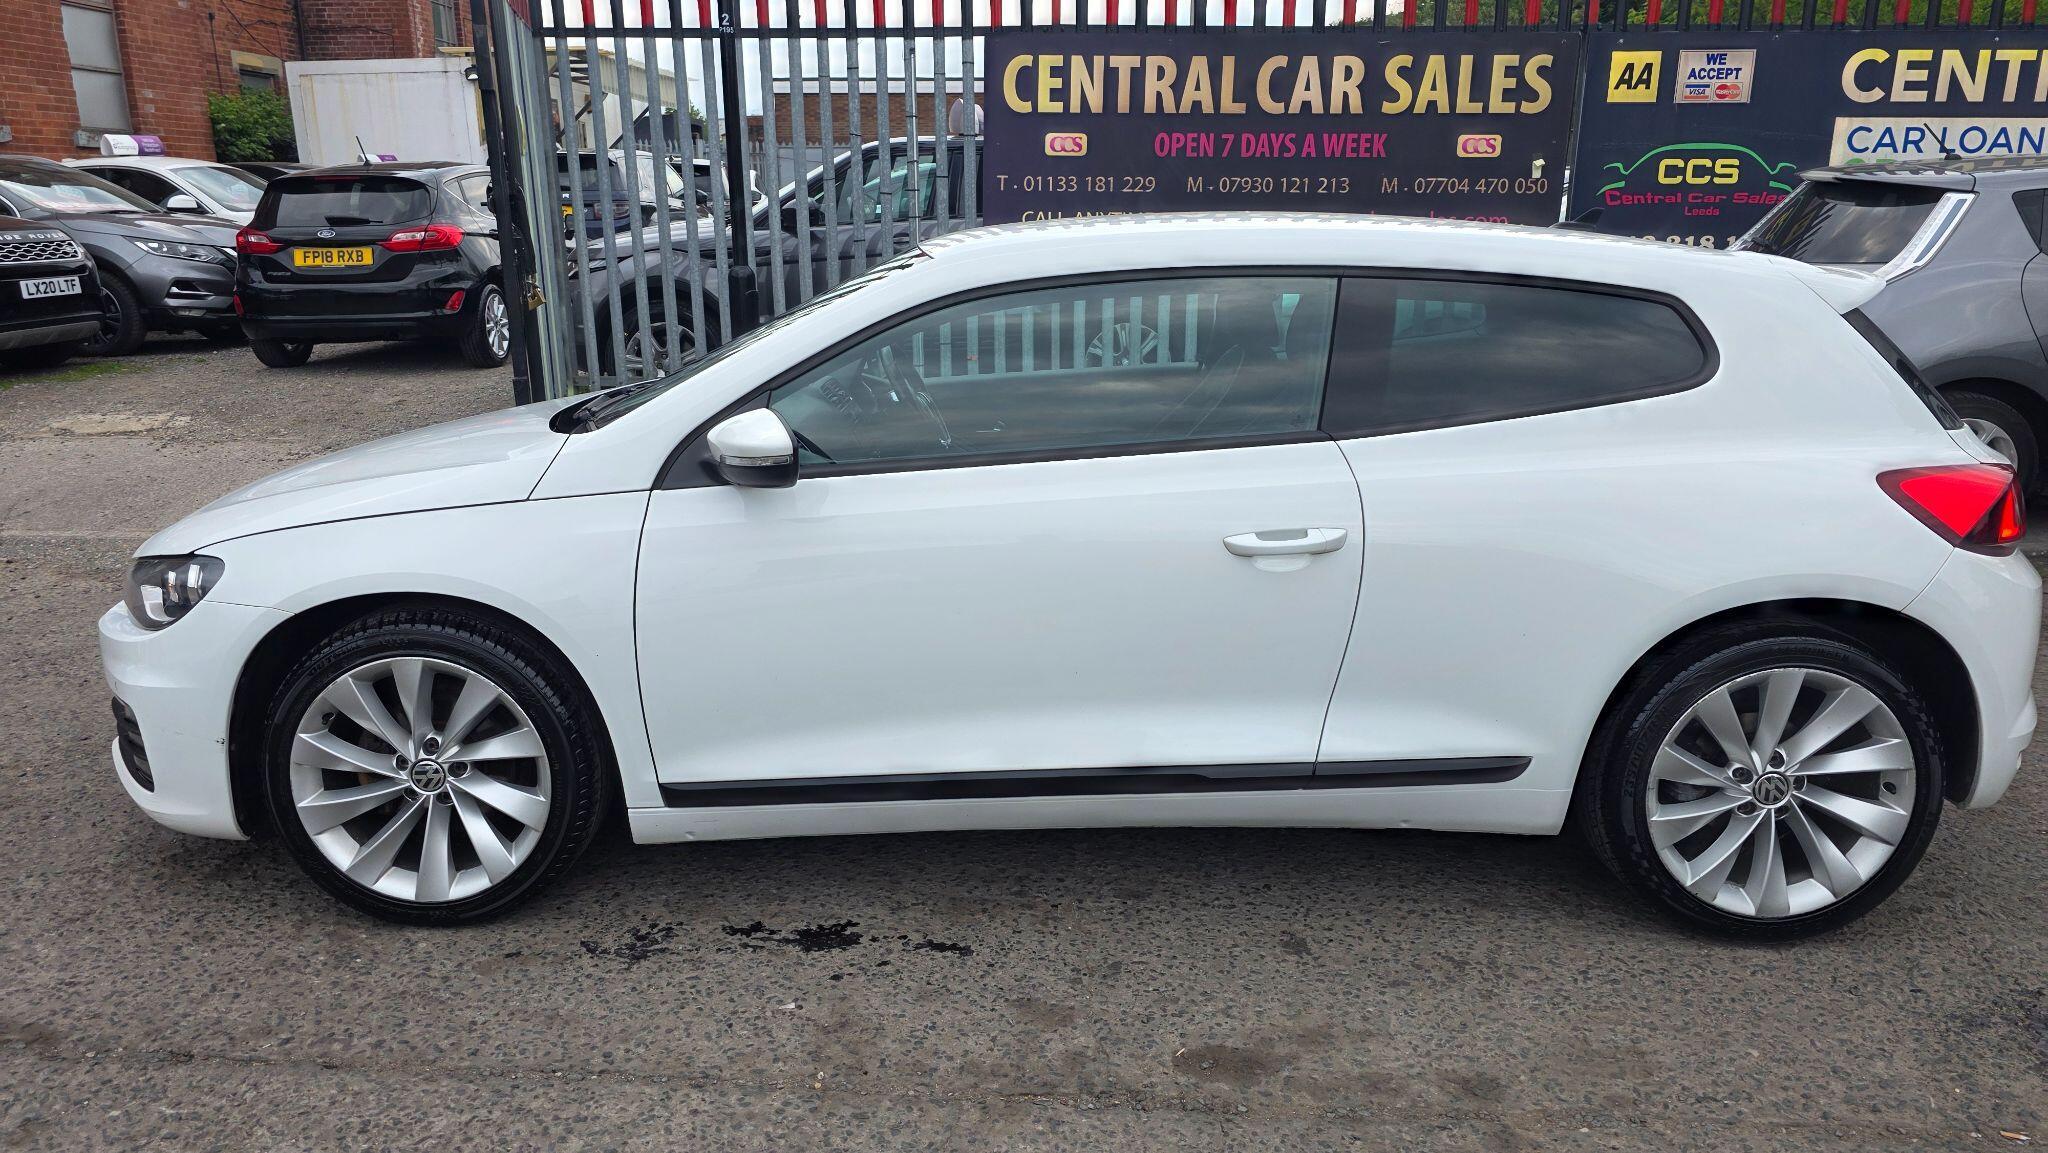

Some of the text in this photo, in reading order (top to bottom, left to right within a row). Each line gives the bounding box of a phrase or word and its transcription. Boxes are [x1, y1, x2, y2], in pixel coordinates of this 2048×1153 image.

[721, 13, 730, 26] 2
[1706, 53, 1728, 66] WE
[1613, 62, 1654, 91] AA
[1687, 67, 1742, 80] ACCEPT
[1003, 53, 1554, 115] CENTRAL CAR SALES
[1689, 88, 1707, 96] VISA
[1154, 132, 1388, 158] OPEN 7 DAYS A WEEK
[1846, 125, 1926, 154] CAR
[1657, 158, 1740, 185] CCS
[1023, 175, 1078, 192] 01133
[1085, 176, 1115, 192] 181
[1121, 176, 1157, 193] 229
[1219, 176, 1274, 193] 07930
[1280, 177, 1310, 193] 121
[1317, 177, 1350, 193] 213
[1414, 178, 1470, 194] 07704
[1475, 178, 1509, 194] 470
[1514, 178, 1548, 194] 050
[1605, 190, 1682, 206] Central
[1687, 193, 1728, 204] Car
[1684, 206, 1720, 216] Leeds
[303, 250, 364, 264] FP18 RXB
[26, 279, 77, 297] LX20 LTF
